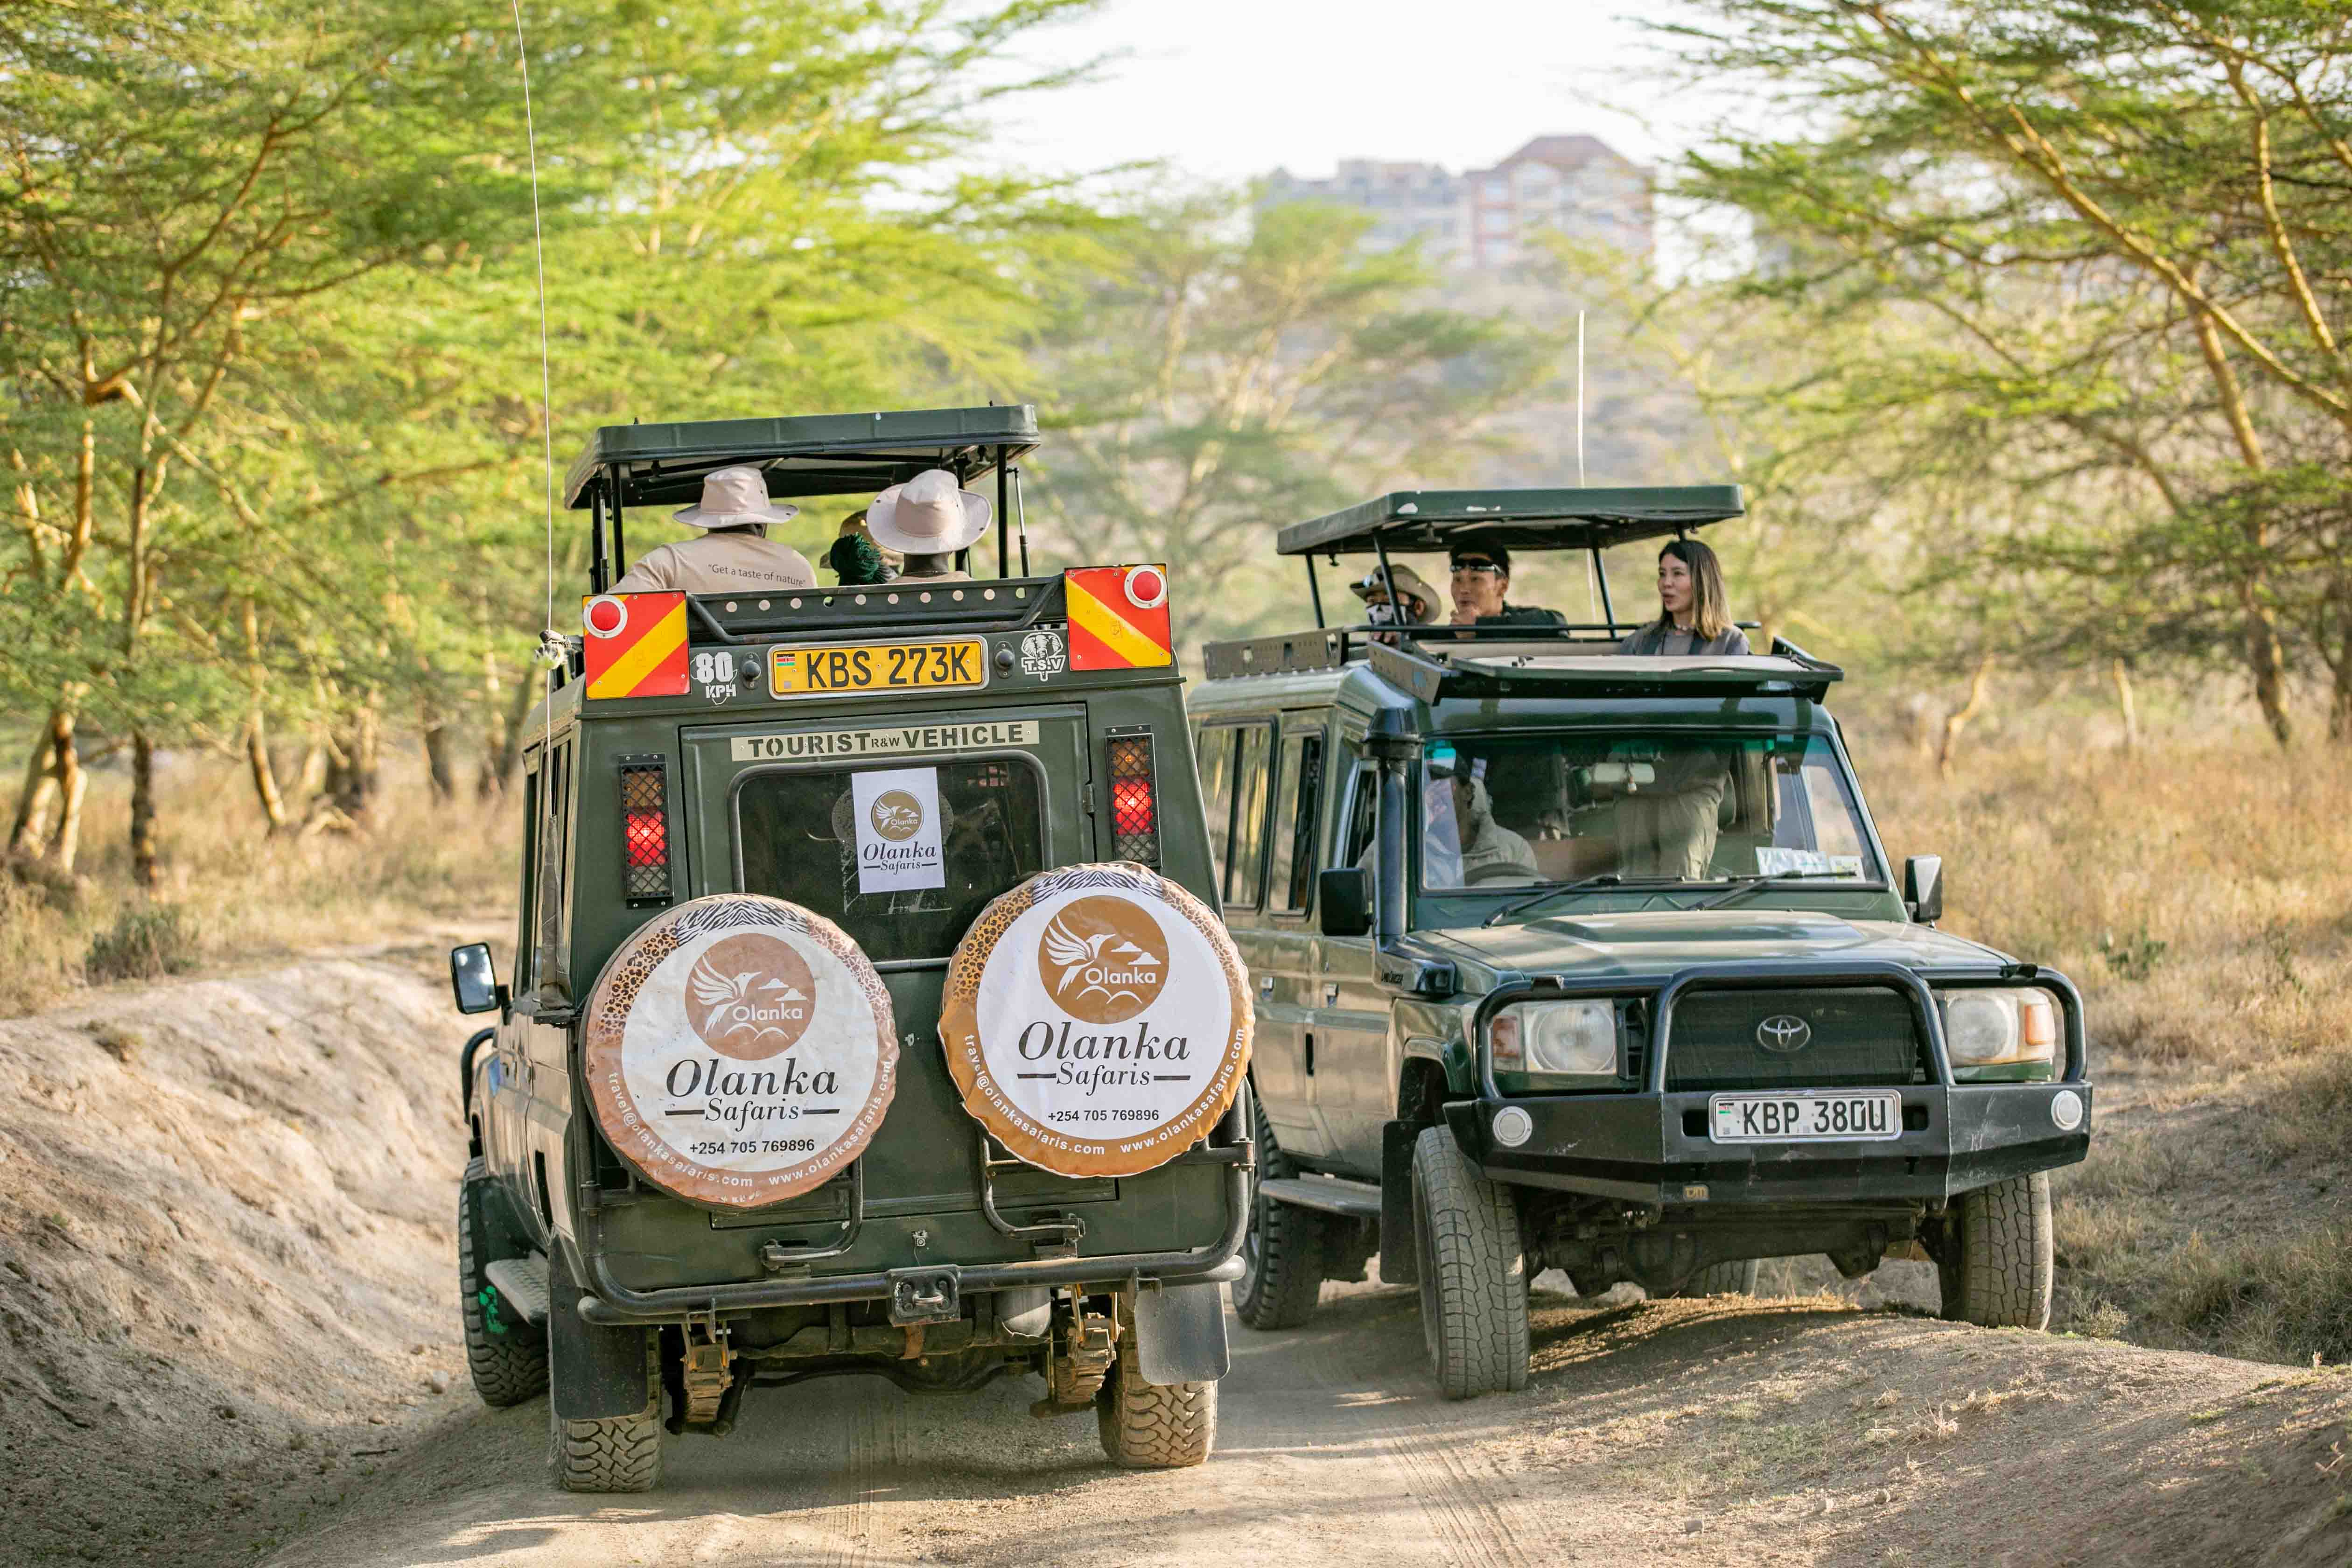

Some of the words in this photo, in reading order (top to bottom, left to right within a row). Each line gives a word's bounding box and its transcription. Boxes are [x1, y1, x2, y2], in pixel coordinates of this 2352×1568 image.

[739, 569, 761, 579] taste
[764, 572, 773, 581] of
[696, 652, 734, 683] 80
[806, 650, 872, 688] KBS
[889, 645, 971, 685] 273K
[705, 684, 736, 698] KPH
[748, 733, 870, 757] TOURIST
[871, 737, 900, 748] R&W
[903, 724, 1023, 748] VEHICLE
[864, 841, 937, 861] Olanka
[881, 859, 921, 875] Safaris
[1085, 967, 1156, 985] Olanka
[732, 1003, 803, 1022] Olanka
[1018, 1021, 1190, 1060] Olanka
[666, 1057, 839, 1098] Olanka
[964, 1034, 1105, 1155] travel@olankasafaris.com
[1120, 1028, 1245, 1153] www.olankasafaris.com
[1057, 1061, 1149, 1096] Safaris
[609, 1072, 753, 1187] travel@olankasafaris.com
[769, 1060, 890, 1185] www.olankasafaris.com
[705, 1098, 799, 1132] Safaris
[1048, 1110, 1079, 1121] +254
[1084, 1110, 1107, 1121] 705
[1112, 1109, 1159, 1120] 769896
[1743, 1102, 1799, 1134] KBP
[1814, 1099, 1886, 1133] 380U
[690, 1142, 725, 1155] +254
[730, 1141, 757, 1153] 705
[762, 1139, 815, 1153] 769896
